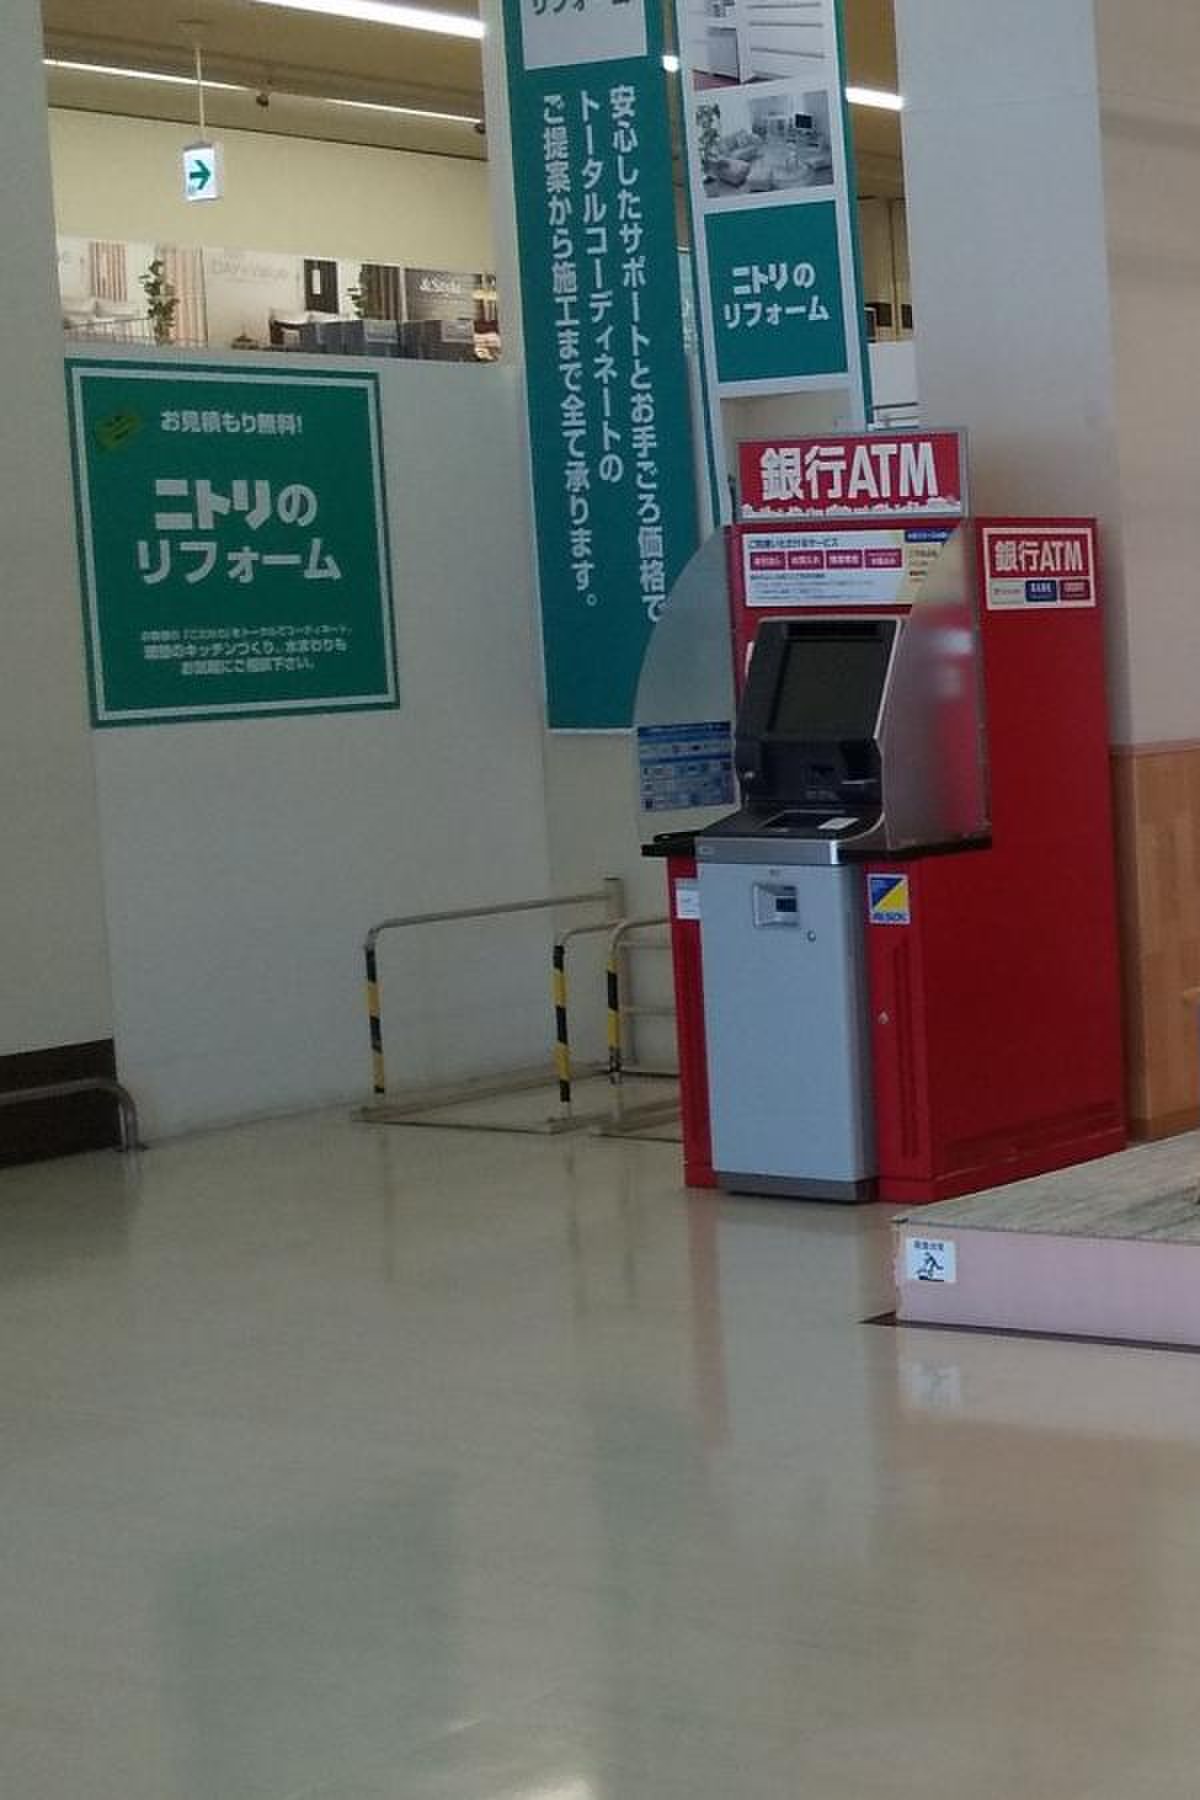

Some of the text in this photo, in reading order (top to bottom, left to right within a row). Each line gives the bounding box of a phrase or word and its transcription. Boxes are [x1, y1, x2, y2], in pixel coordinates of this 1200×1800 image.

[580, 90, 624, 483] トータルコーディネートの
[732, 262, 816, 295] ニトリの
[723, 295, 831, 329] リフォーム
[543, 94, 598, 606] ご提案から施工まで全て承ります。
[609, 84, 669, 622] 安心したサポートとお手ごろ価格で
[760, 441, 940, 501] 銀行ATM
[154, 479, 319, 531] ニトリの
[136, 537, 343, 585] リフォーム
[994, 540, 1083, 572] 銀行ATM
